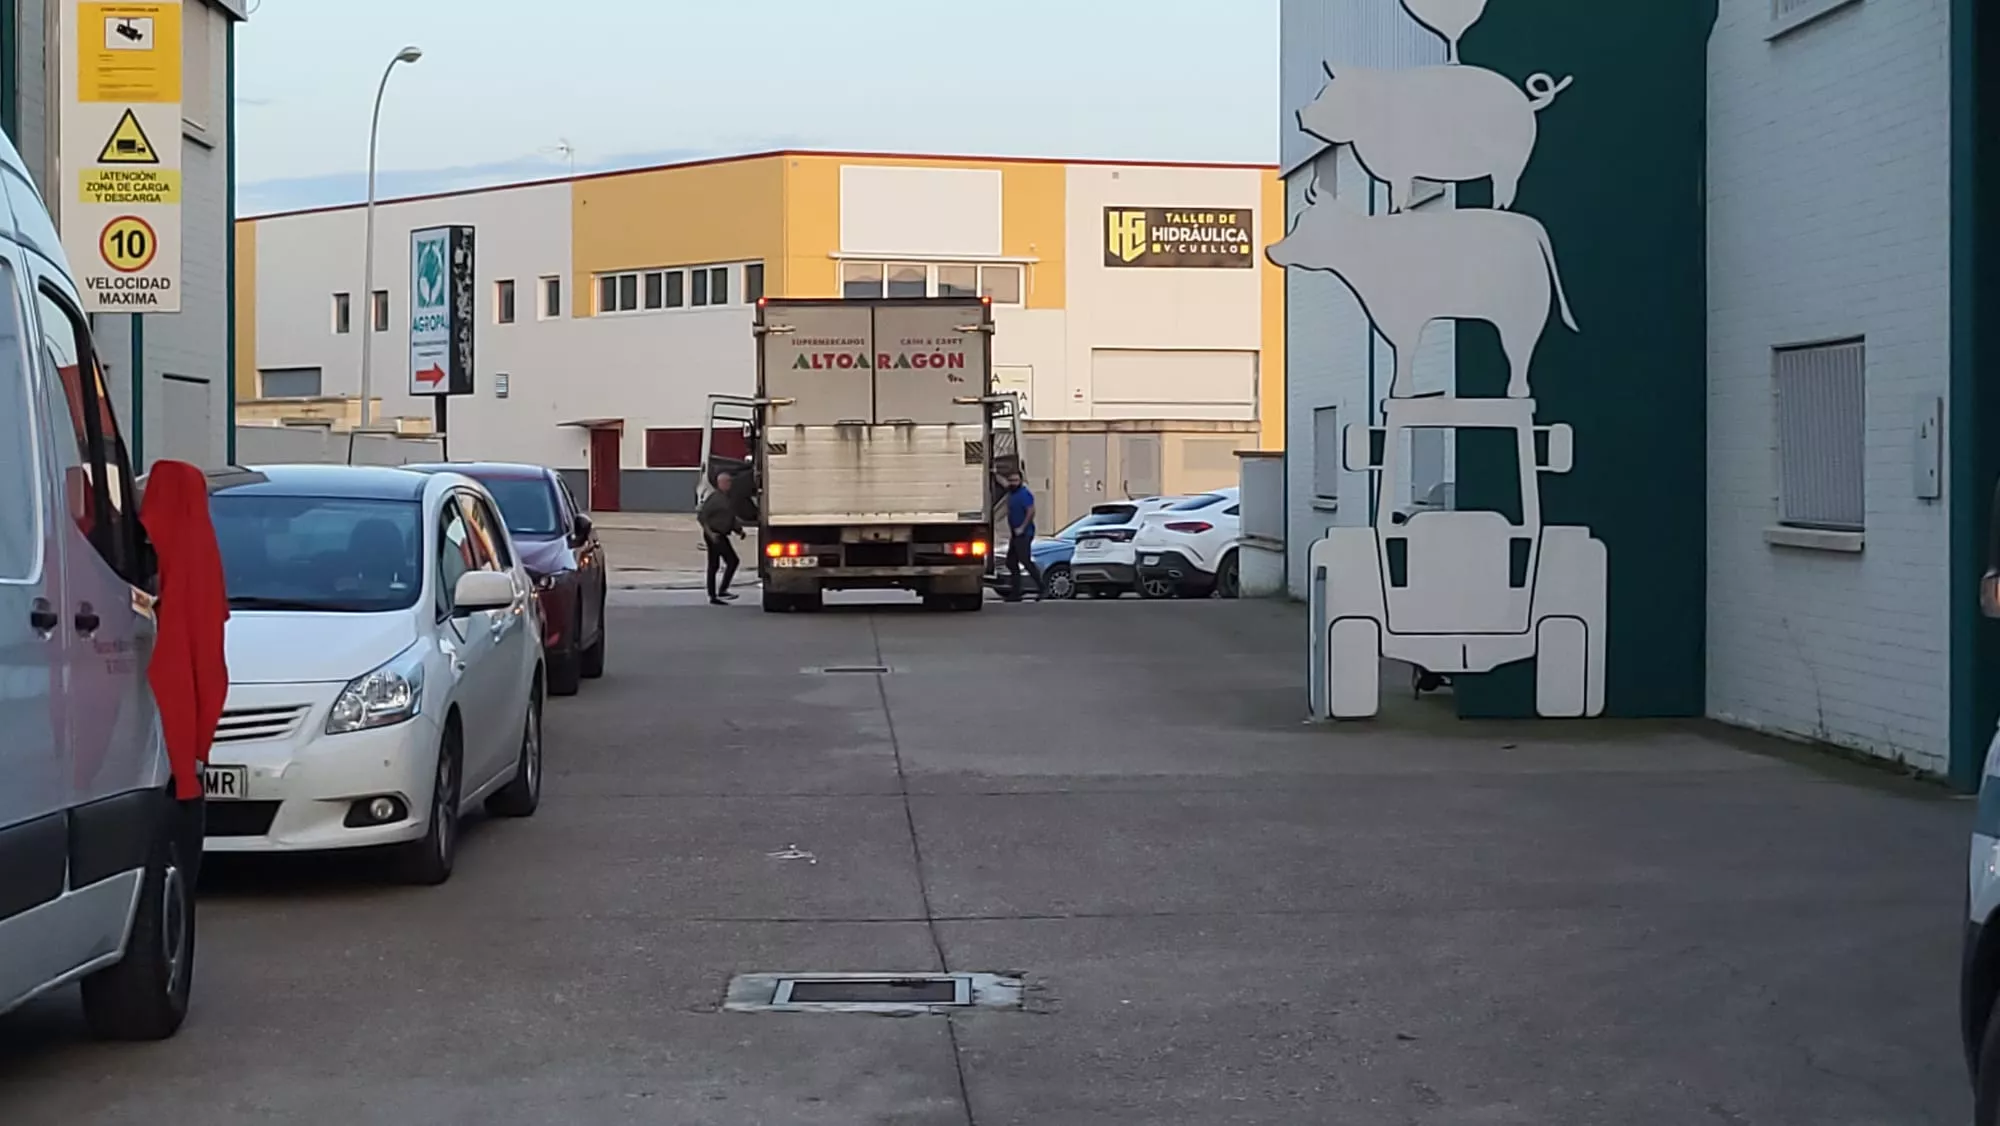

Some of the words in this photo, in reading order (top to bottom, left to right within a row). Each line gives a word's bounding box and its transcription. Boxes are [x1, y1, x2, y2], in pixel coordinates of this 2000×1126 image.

[86, 183, 115, 192] ZONA
[117, 183, 131, 192] DE
[133, 183, 170, 192] CARGA
[95, 193, 102, 202] Y
[104, 193, 161, 202] DESCARGA
[1165, 213, 1214, 223] TALLER
[1219, 214, 1236, 224] DE
[1152, 223, 1248, 242] HIDRÁULICA
[110, 230, 146, 258] 10
[1179, 244, 1238, 253] CUELLO
[86, 277, 171, 290] VELOCIDAD
[99, 293, 158, 305] MAXIMA
[792, 338, 865, 346] SUPERMERCADOS
[901, 338, 924, 346] CASH
[205, 771, 235, 795] MR
